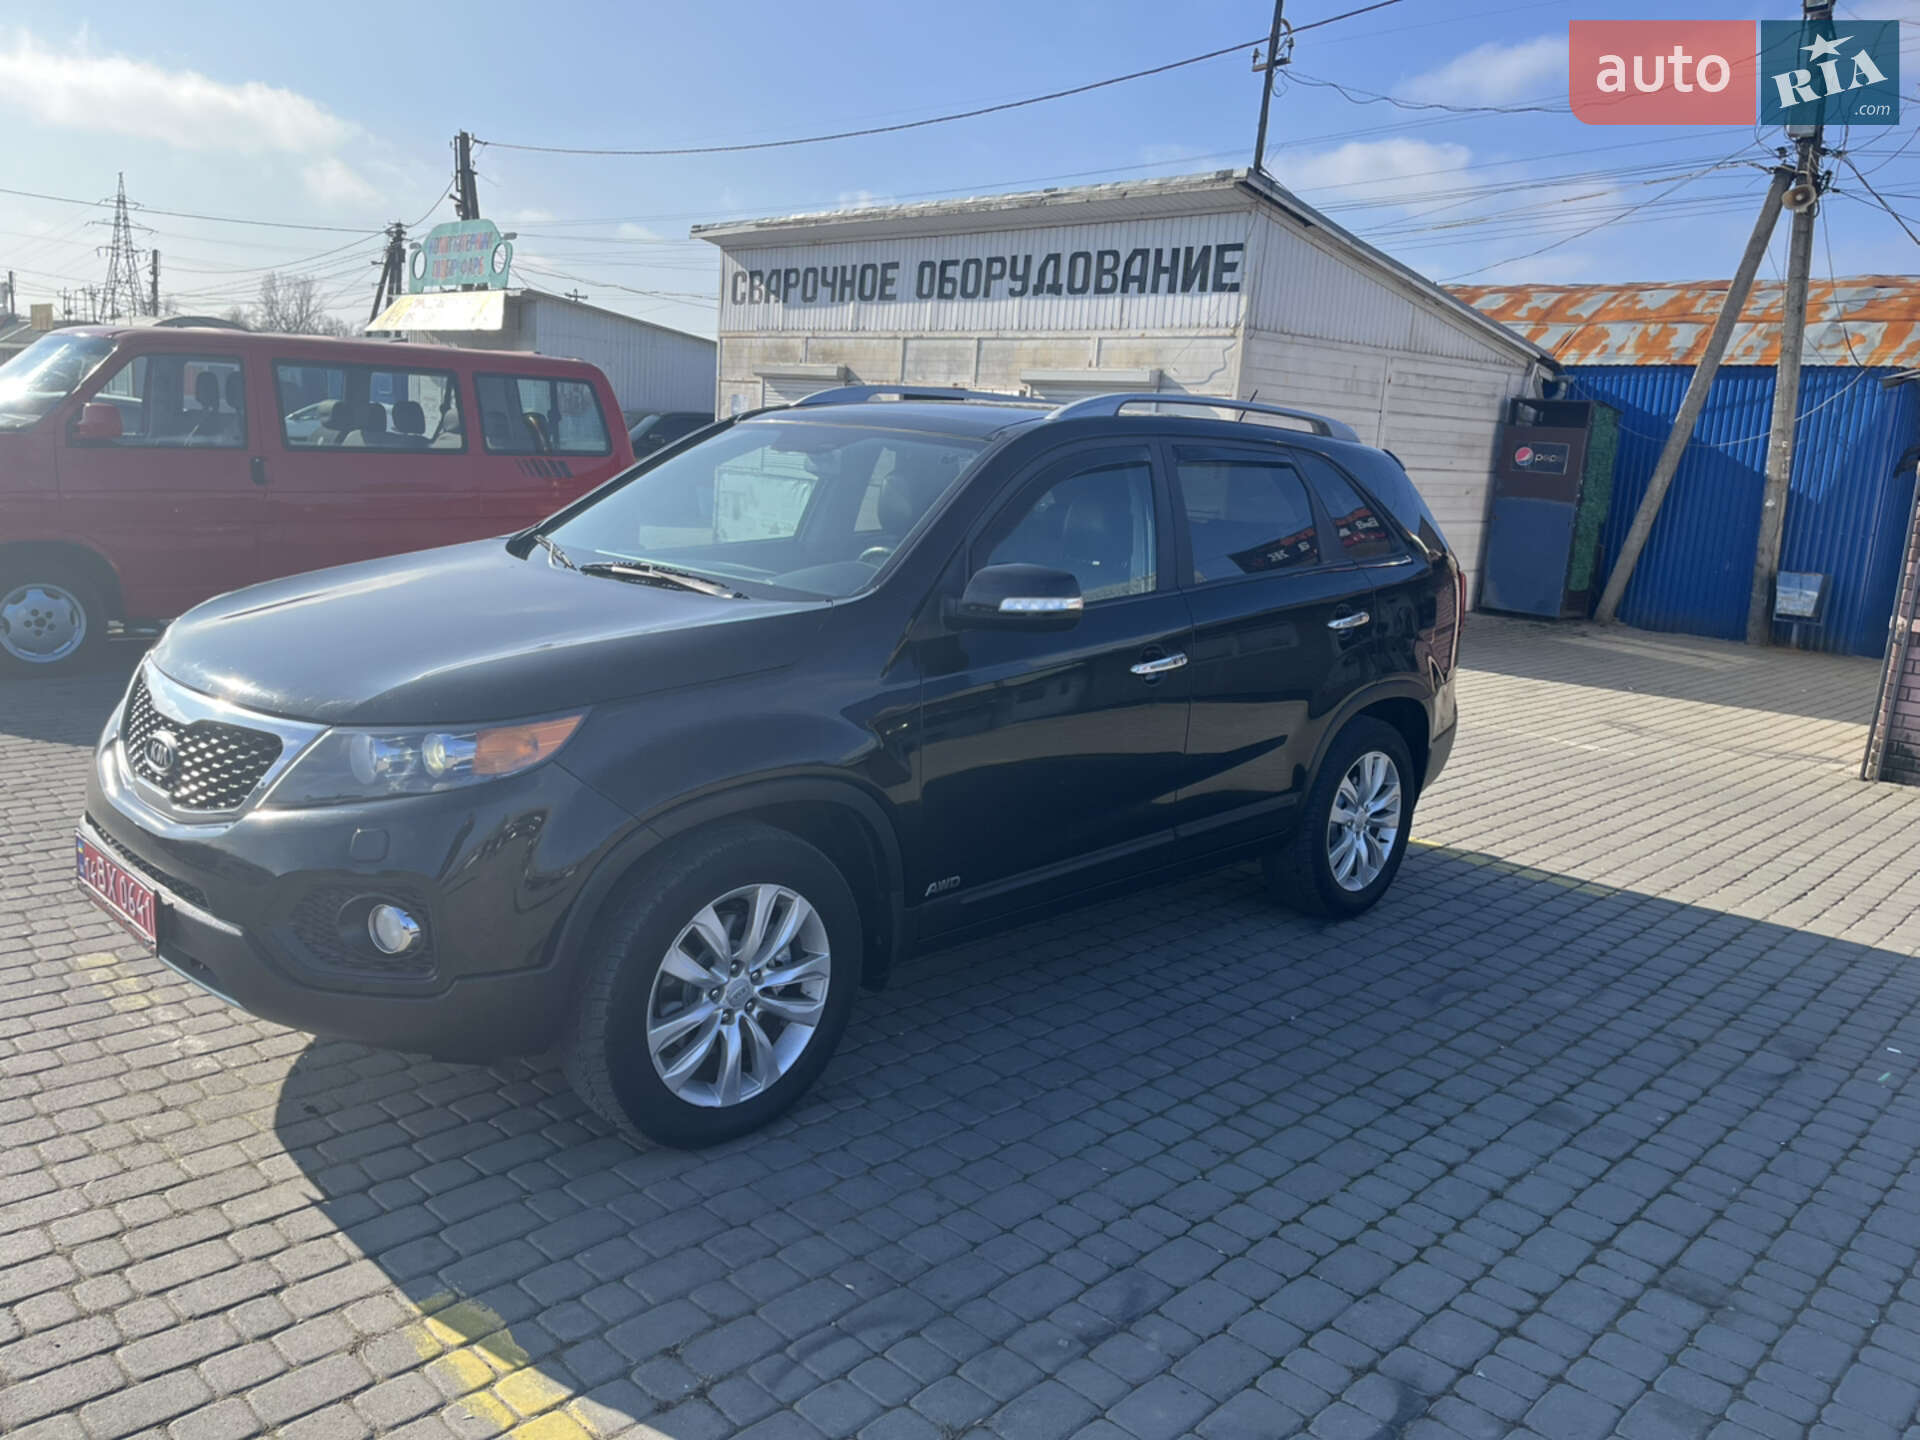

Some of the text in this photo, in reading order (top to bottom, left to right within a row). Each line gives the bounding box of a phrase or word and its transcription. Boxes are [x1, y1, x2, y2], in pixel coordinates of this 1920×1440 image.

[731, 243, 1244, 305] СВАРОЧНОЕ ОБОРУДОВАНИЕ
[924, 875, 961, 896] AWD
